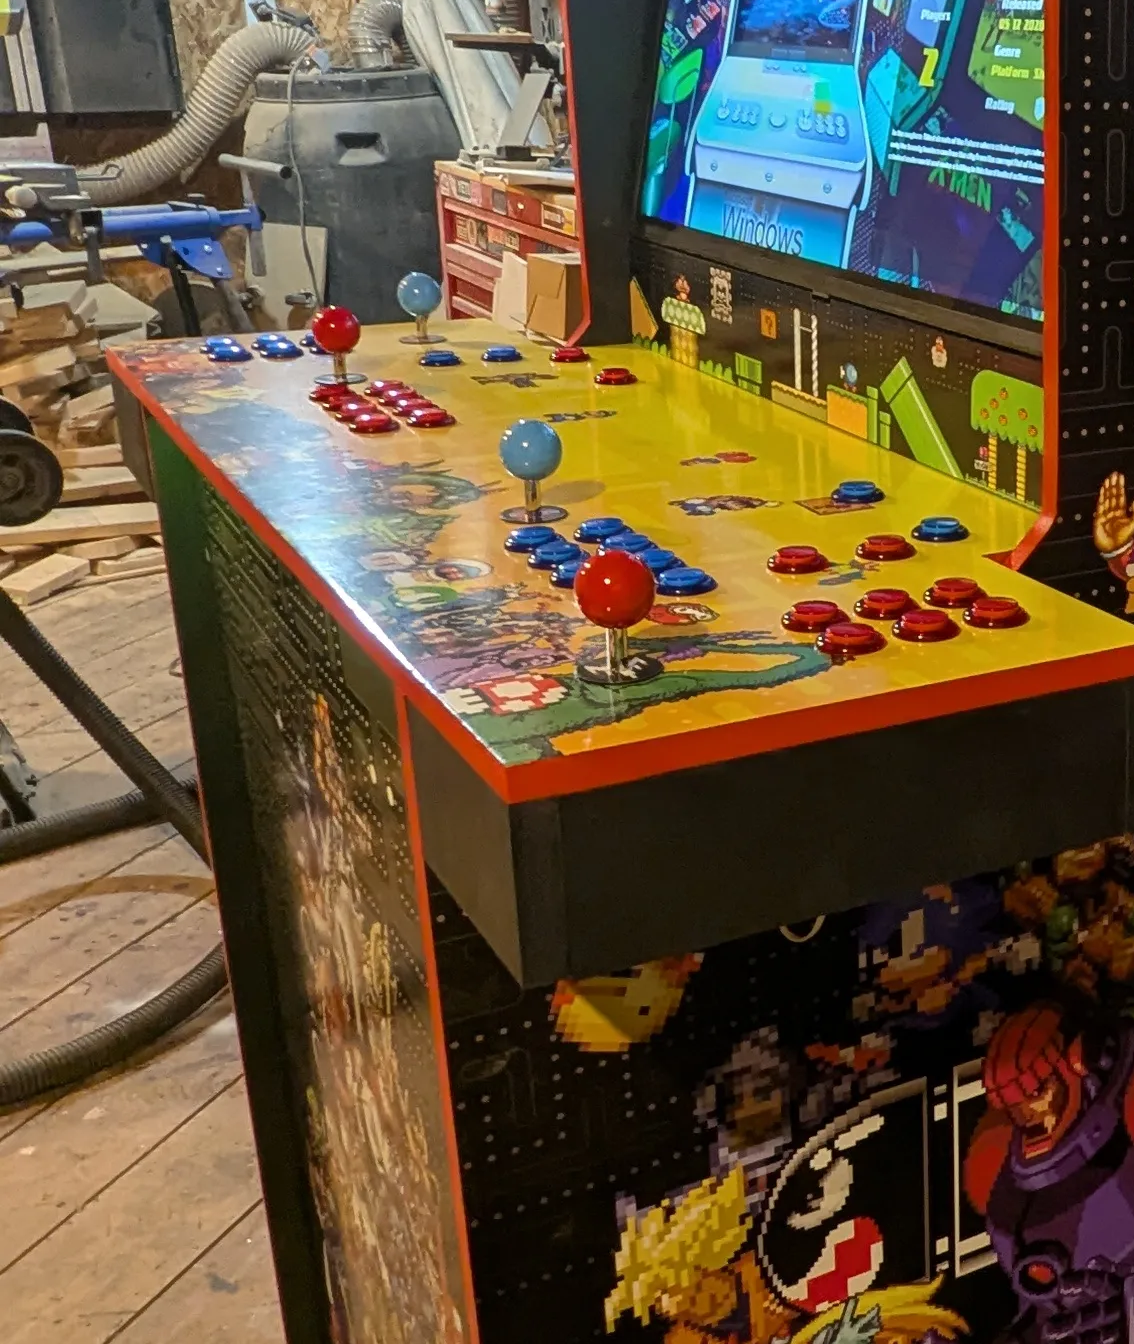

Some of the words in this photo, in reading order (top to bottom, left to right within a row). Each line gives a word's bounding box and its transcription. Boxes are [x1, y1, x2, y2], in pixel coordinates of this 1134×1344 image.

[920, 8, 952, 23] Players
[993, 44, 1022, 59] Genre
[918, 47, 940, 88] 2
[990, 64, 1030, 79] Platform
[984, 96, 1016, 115] Rating
[722, 202, 804, 256] Windows
